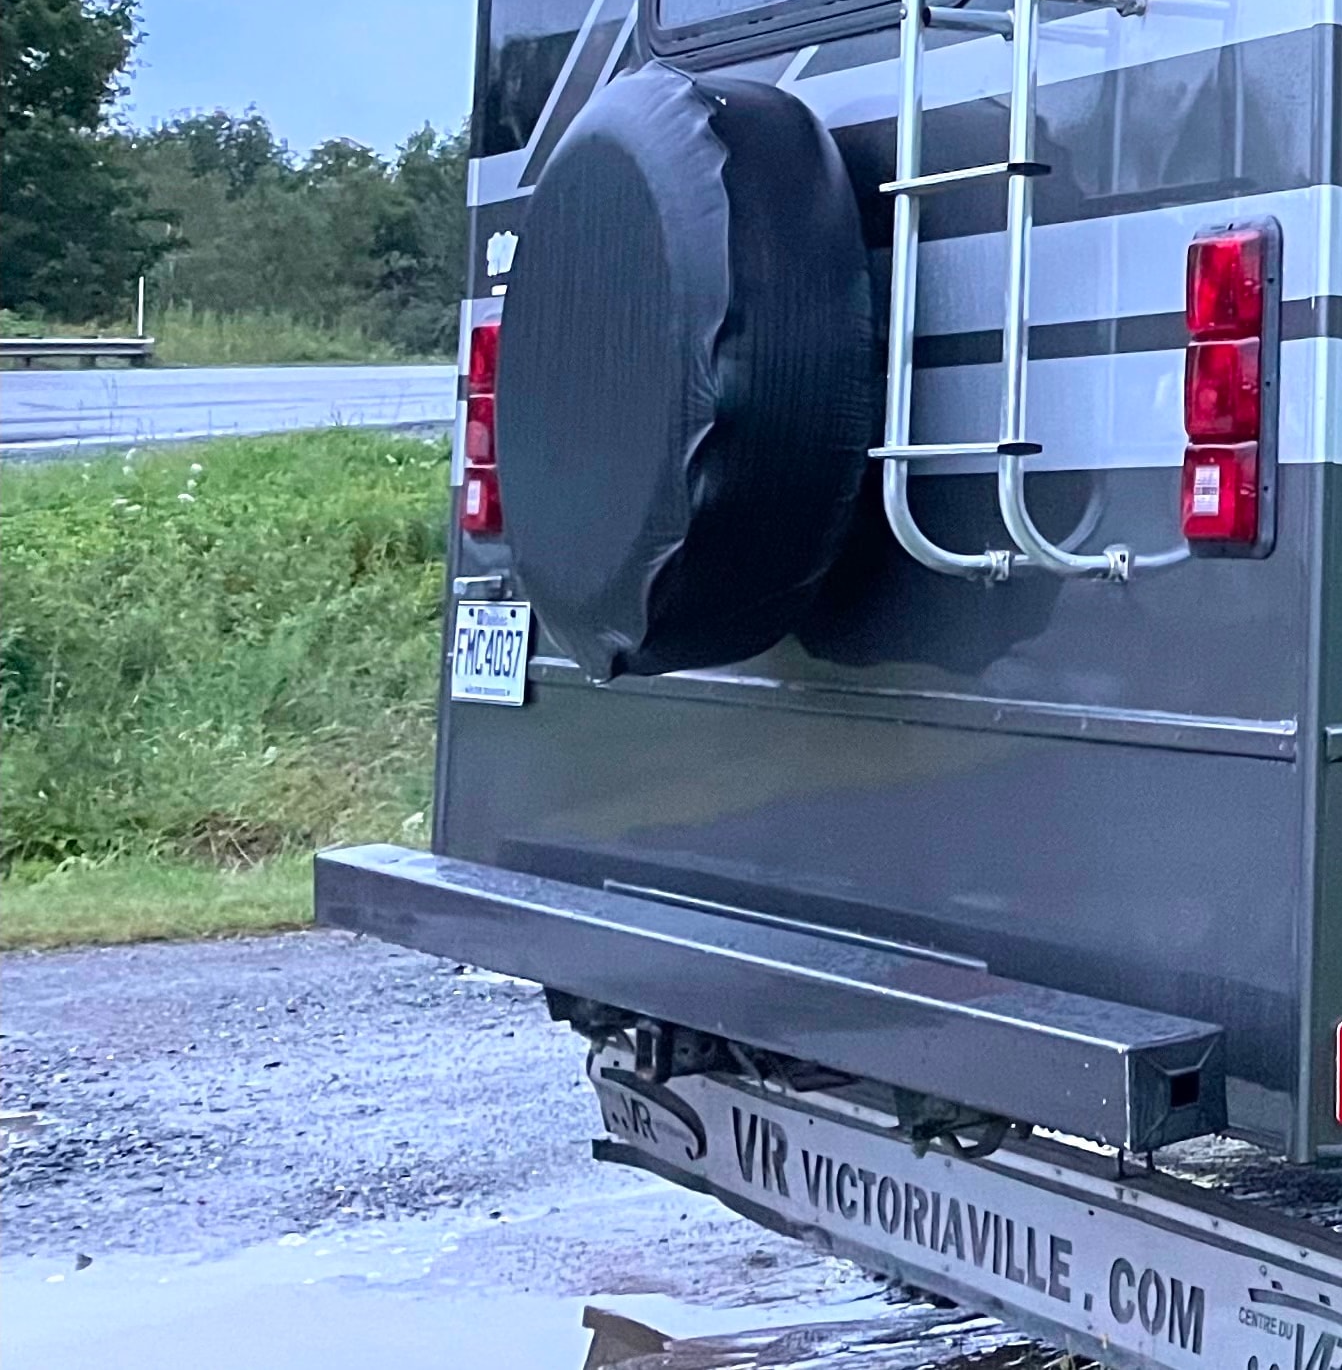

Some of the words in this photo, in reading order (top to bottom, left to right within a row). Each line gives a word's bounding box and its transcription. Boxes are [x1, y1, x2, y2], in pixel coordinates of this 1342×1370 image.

[455, 628, 523, 679] FMC4037
[731, 1105, 790, 1198] VR
[1238, 1306, 1277, 1336] CENTRE
[1278, 1317, 1294, 1341] DU
